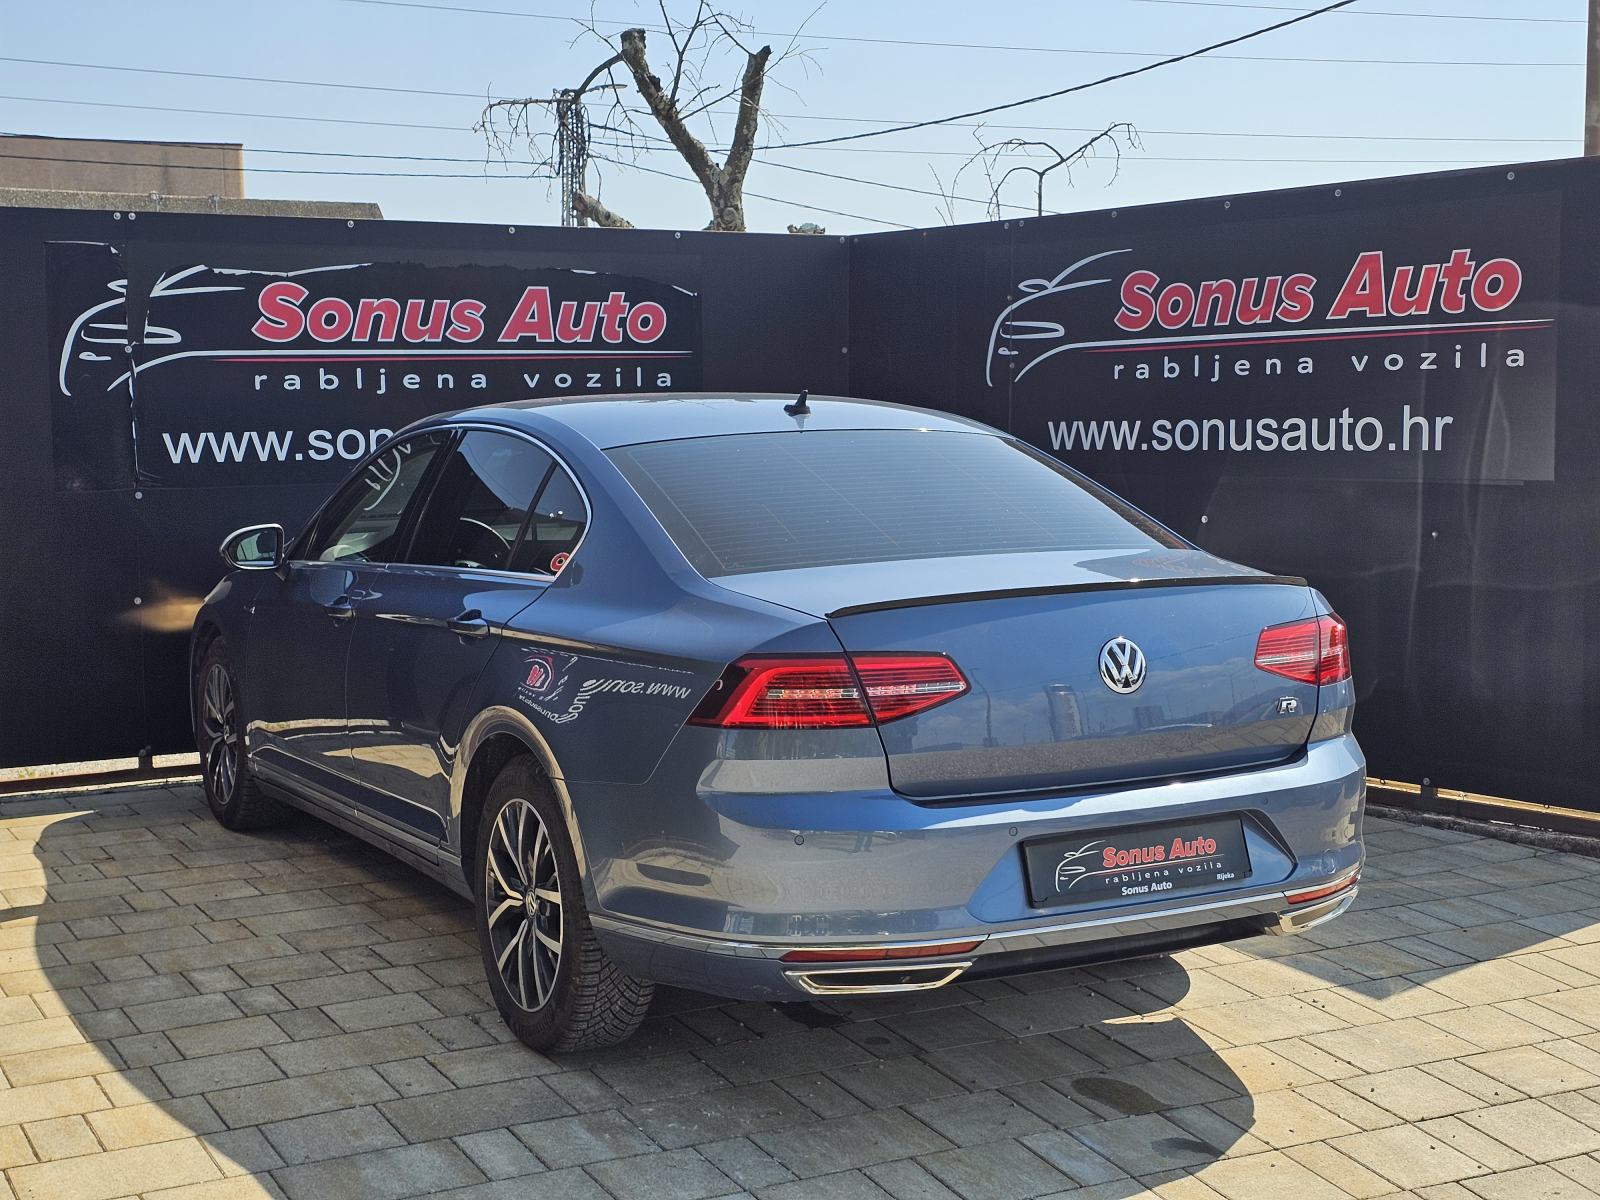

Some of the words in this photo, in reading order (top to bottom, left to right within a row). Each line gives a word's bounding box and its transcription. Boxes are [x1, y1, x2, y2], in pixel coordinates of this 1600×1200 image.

[1113, 269, 1317, 333] Sonus
[1326, 248, 1523, 320] Auto
[251, 281, 488, 343] Sonus
[497, 285, 668, 344] Auto
[1113, 354, 1314, 383] rabljena
[1351, 342, 1526, 373] vozila
[254, 367, 488, 396] rabljena
[523, 366, 672, 389] vozila
[1047, 404, 1454, 452] www.sonusauto.hr
[1102, 844, 1165, 868] Sonus
[1169, 836, 1217, 860] Auto
[1105, 869, 1169, 884] rabljena
[1178, 862, 1222, 873] vozila
[1121, 884, 1149, 896] Sonus
[1151, 880, 1173, 892] Auto
